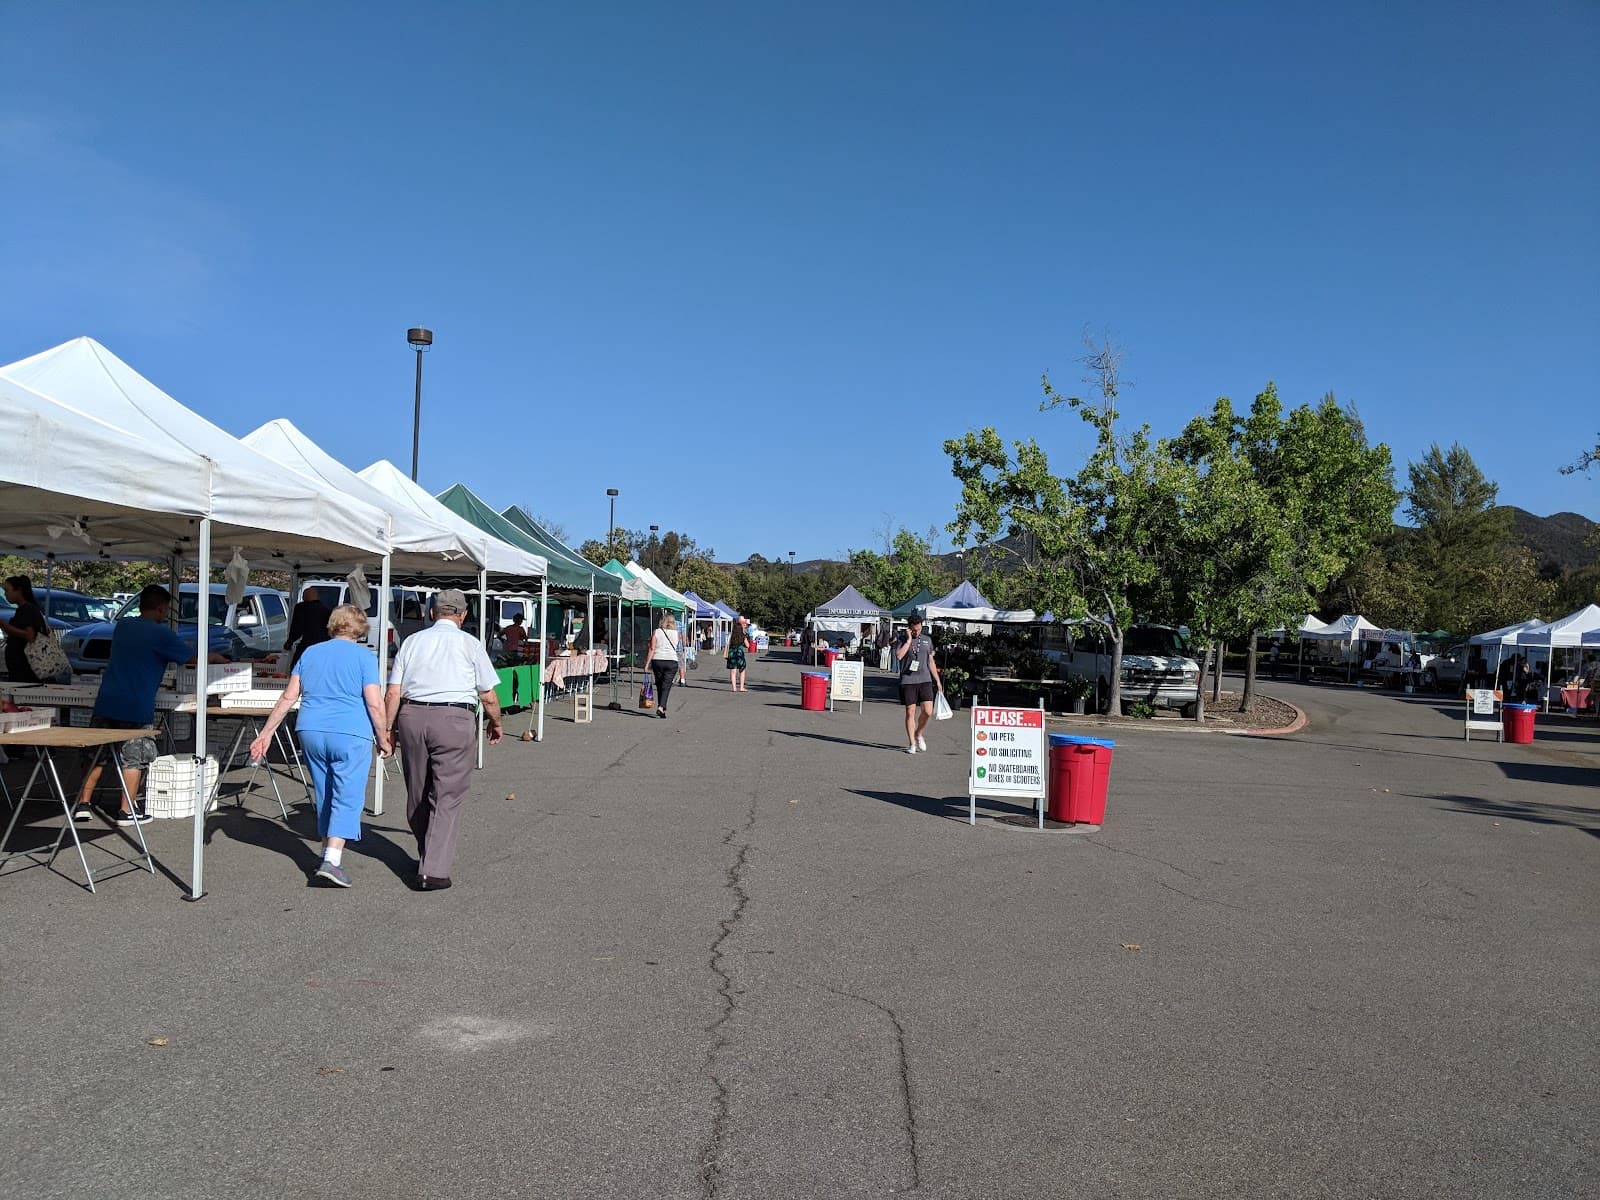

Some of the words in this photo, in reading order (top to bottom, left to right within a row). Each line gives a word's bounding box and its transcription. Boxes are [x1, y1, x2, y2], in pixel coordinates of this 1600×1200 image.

[976, 710, 1037, 726] PLEASE...
[989, 732, 998, 741] NO
[1000, 732, 1015, 741] PETS
[989, 747, 998, 756] NO
[998, 748, 1032, 758] SOLICITING
[989, 763, 997, 772] NO
[998, 763, 1040, 775] SKATEBOARDS,
[989, 774, 1005, 783] BIKES
[1013, 775, 1040, 785] SCOOTERS
